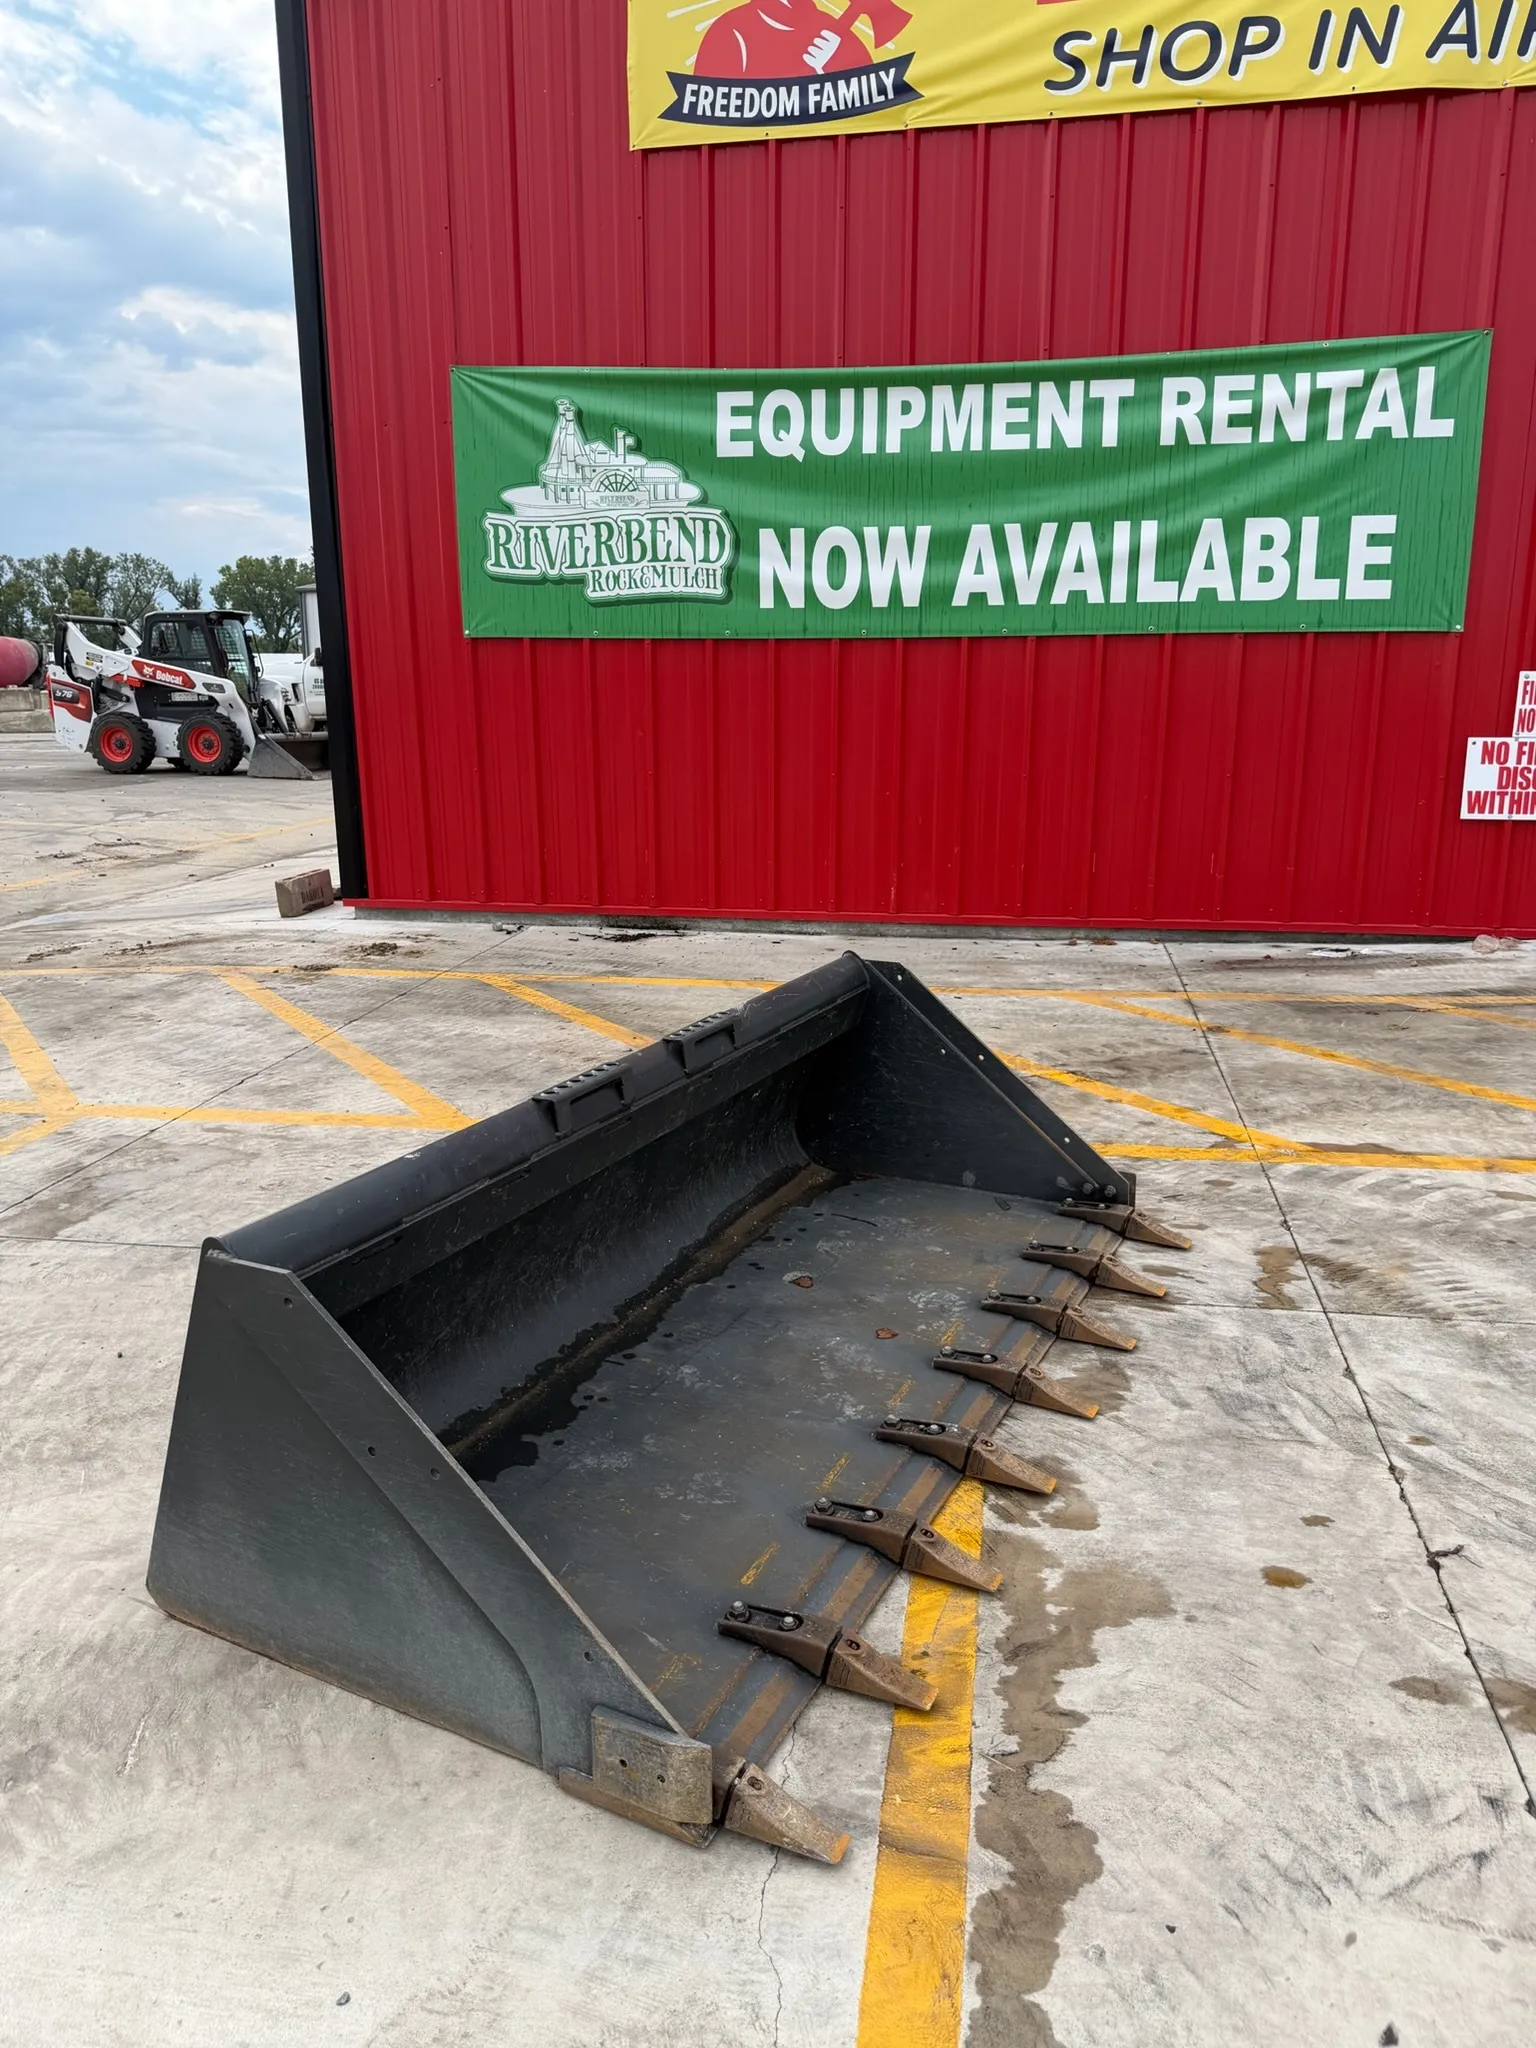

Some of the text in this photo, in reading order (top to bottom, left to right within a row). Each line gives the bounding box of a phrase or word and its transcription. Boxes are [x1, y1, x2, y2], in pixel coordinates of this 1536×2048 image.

[1043, 15, 1284, 94] SHOP
[1308, 4, 1404, 73] IN
[682, 67, 896, 118] FREEDOM FAMILY
[716, 365, 1456, 462] EQUIPMENT RENTAL
[489, 516, 727, 570] RIVERBEND
[759, 514, 1397, 610] NOW AVAILABLE
[156, 670, 184, 685] Bobcat
[1521, 680, 1536, 705] FI
[1480, 741, 1536, 765] NO FI
